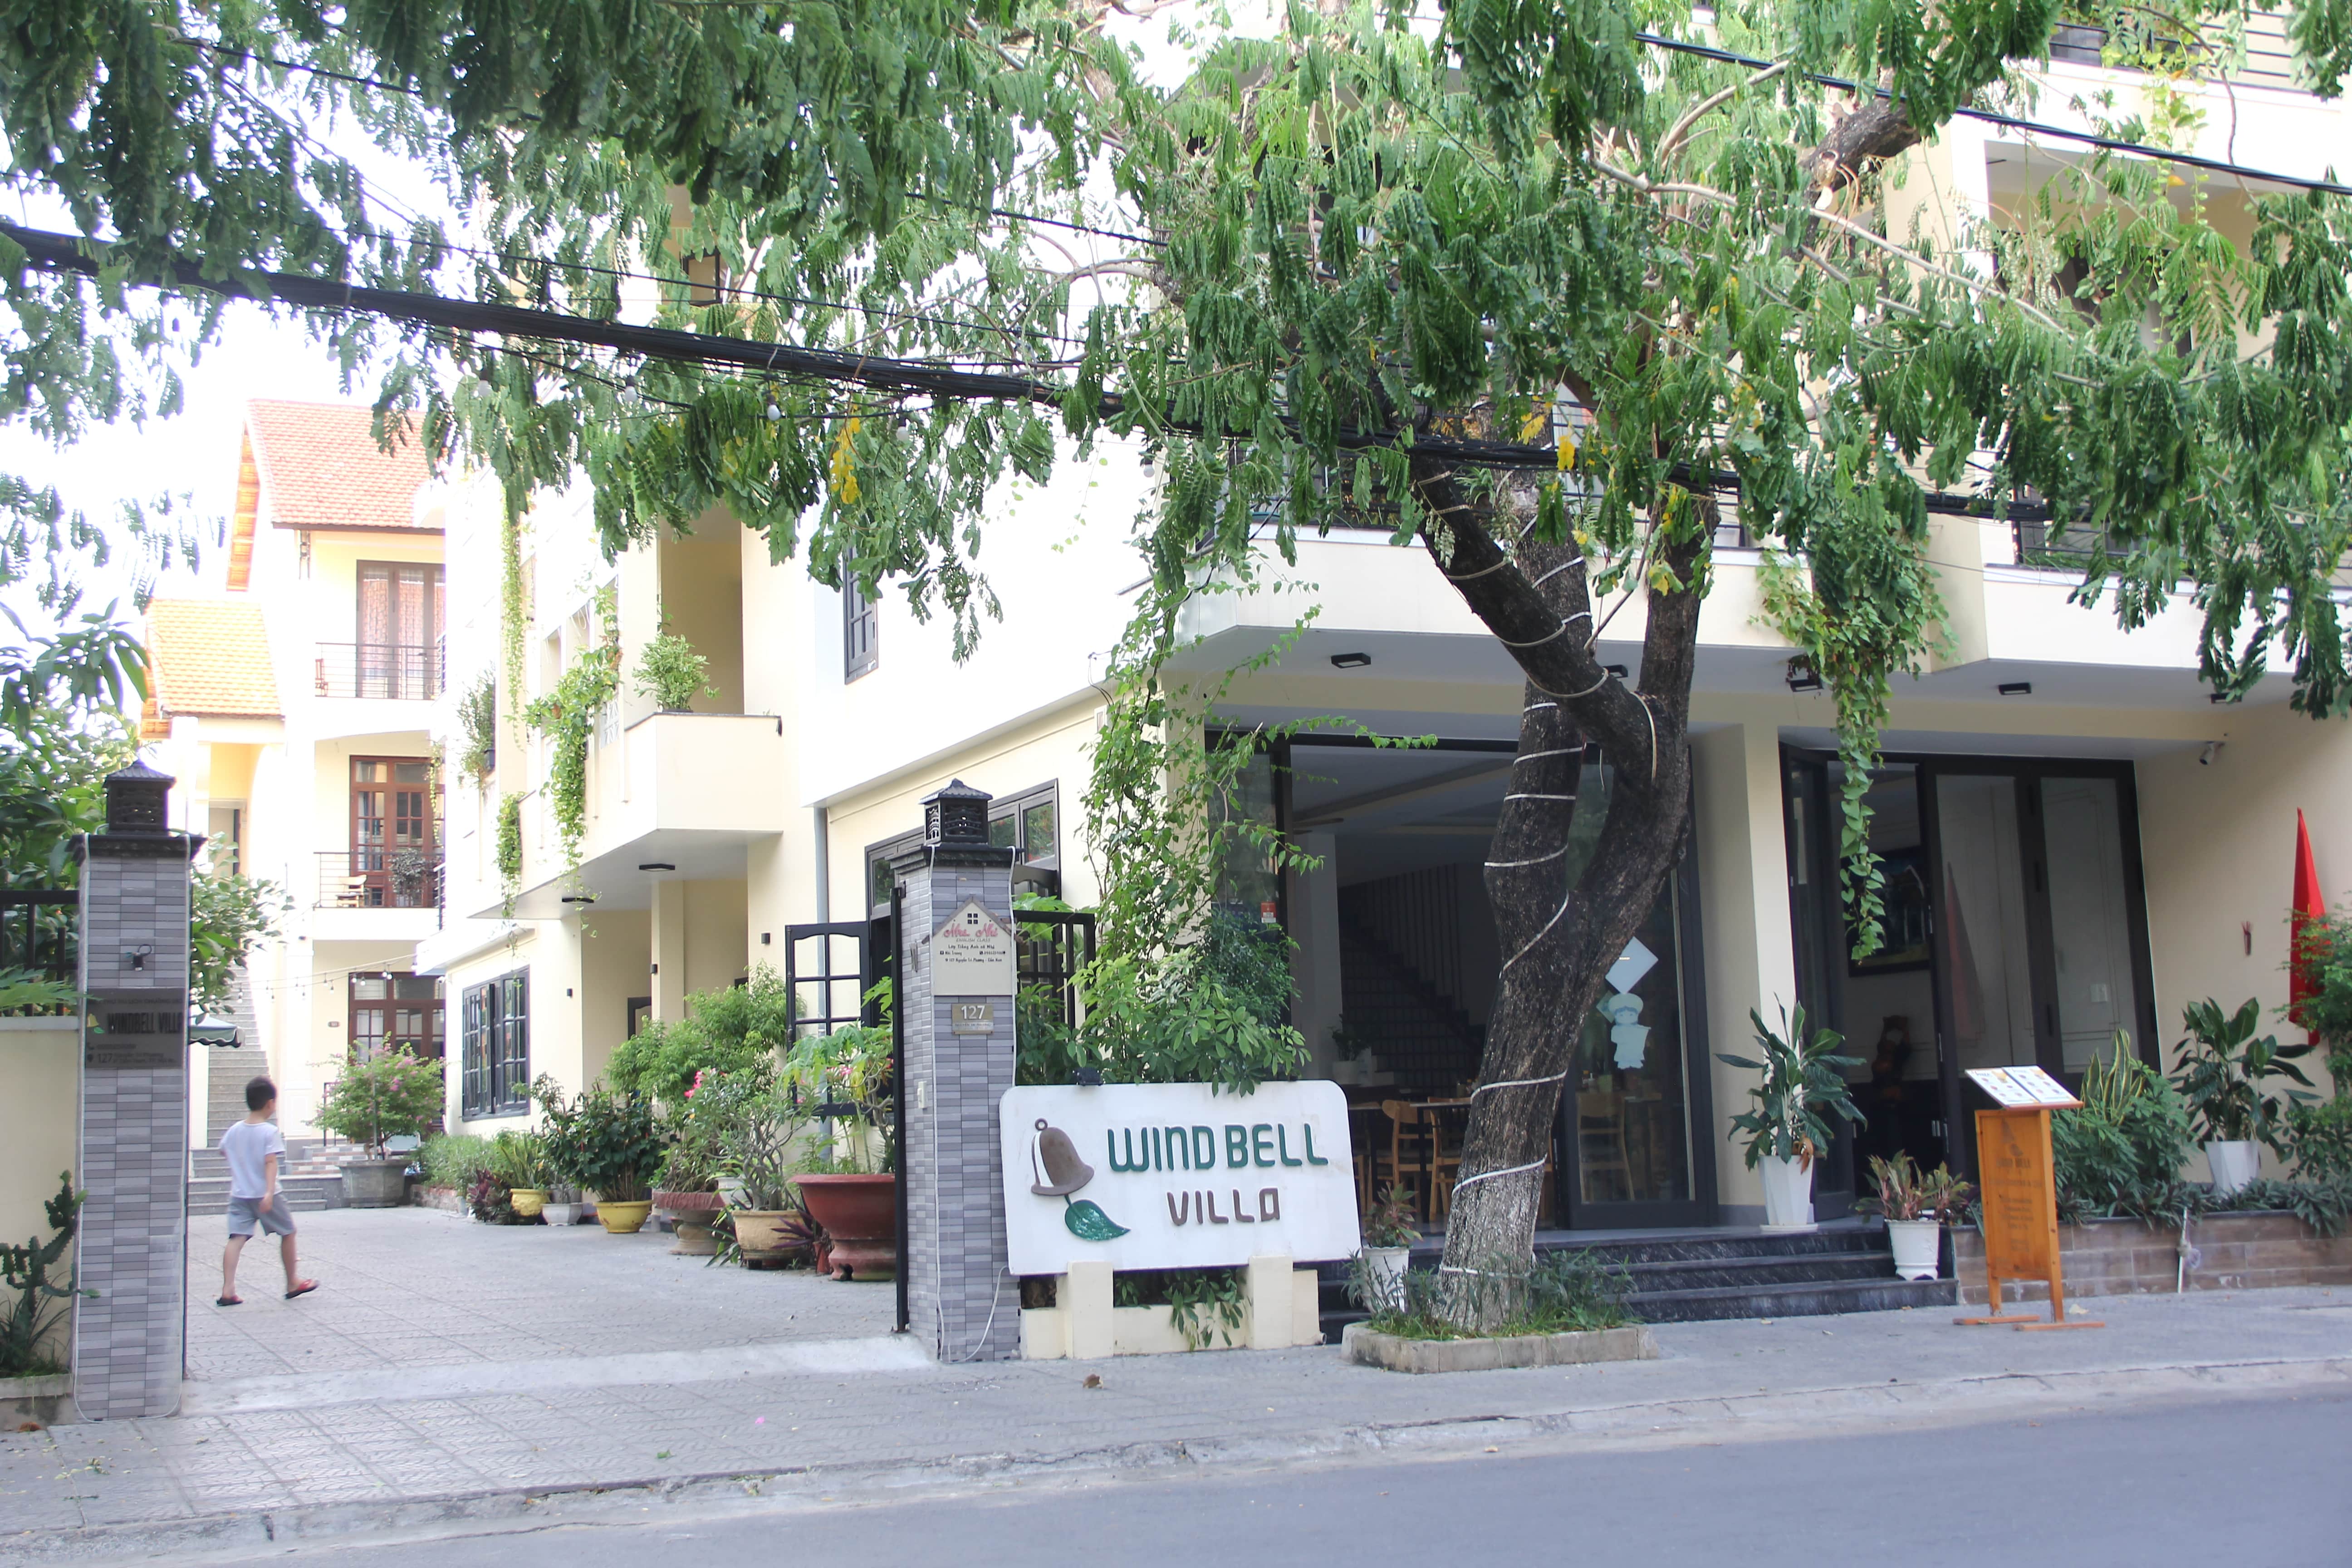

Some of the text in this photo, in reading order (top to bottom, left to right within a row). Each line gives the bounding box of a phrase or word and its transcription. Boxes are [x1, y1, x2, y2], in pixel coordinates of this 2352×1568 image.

[976, 922, 998, 937] Nhi
[961, 1005, 985, 1020] 127
[97, 1053, 113, 1063] 127
[1166, 1187, 1281, 1226] VILLA
